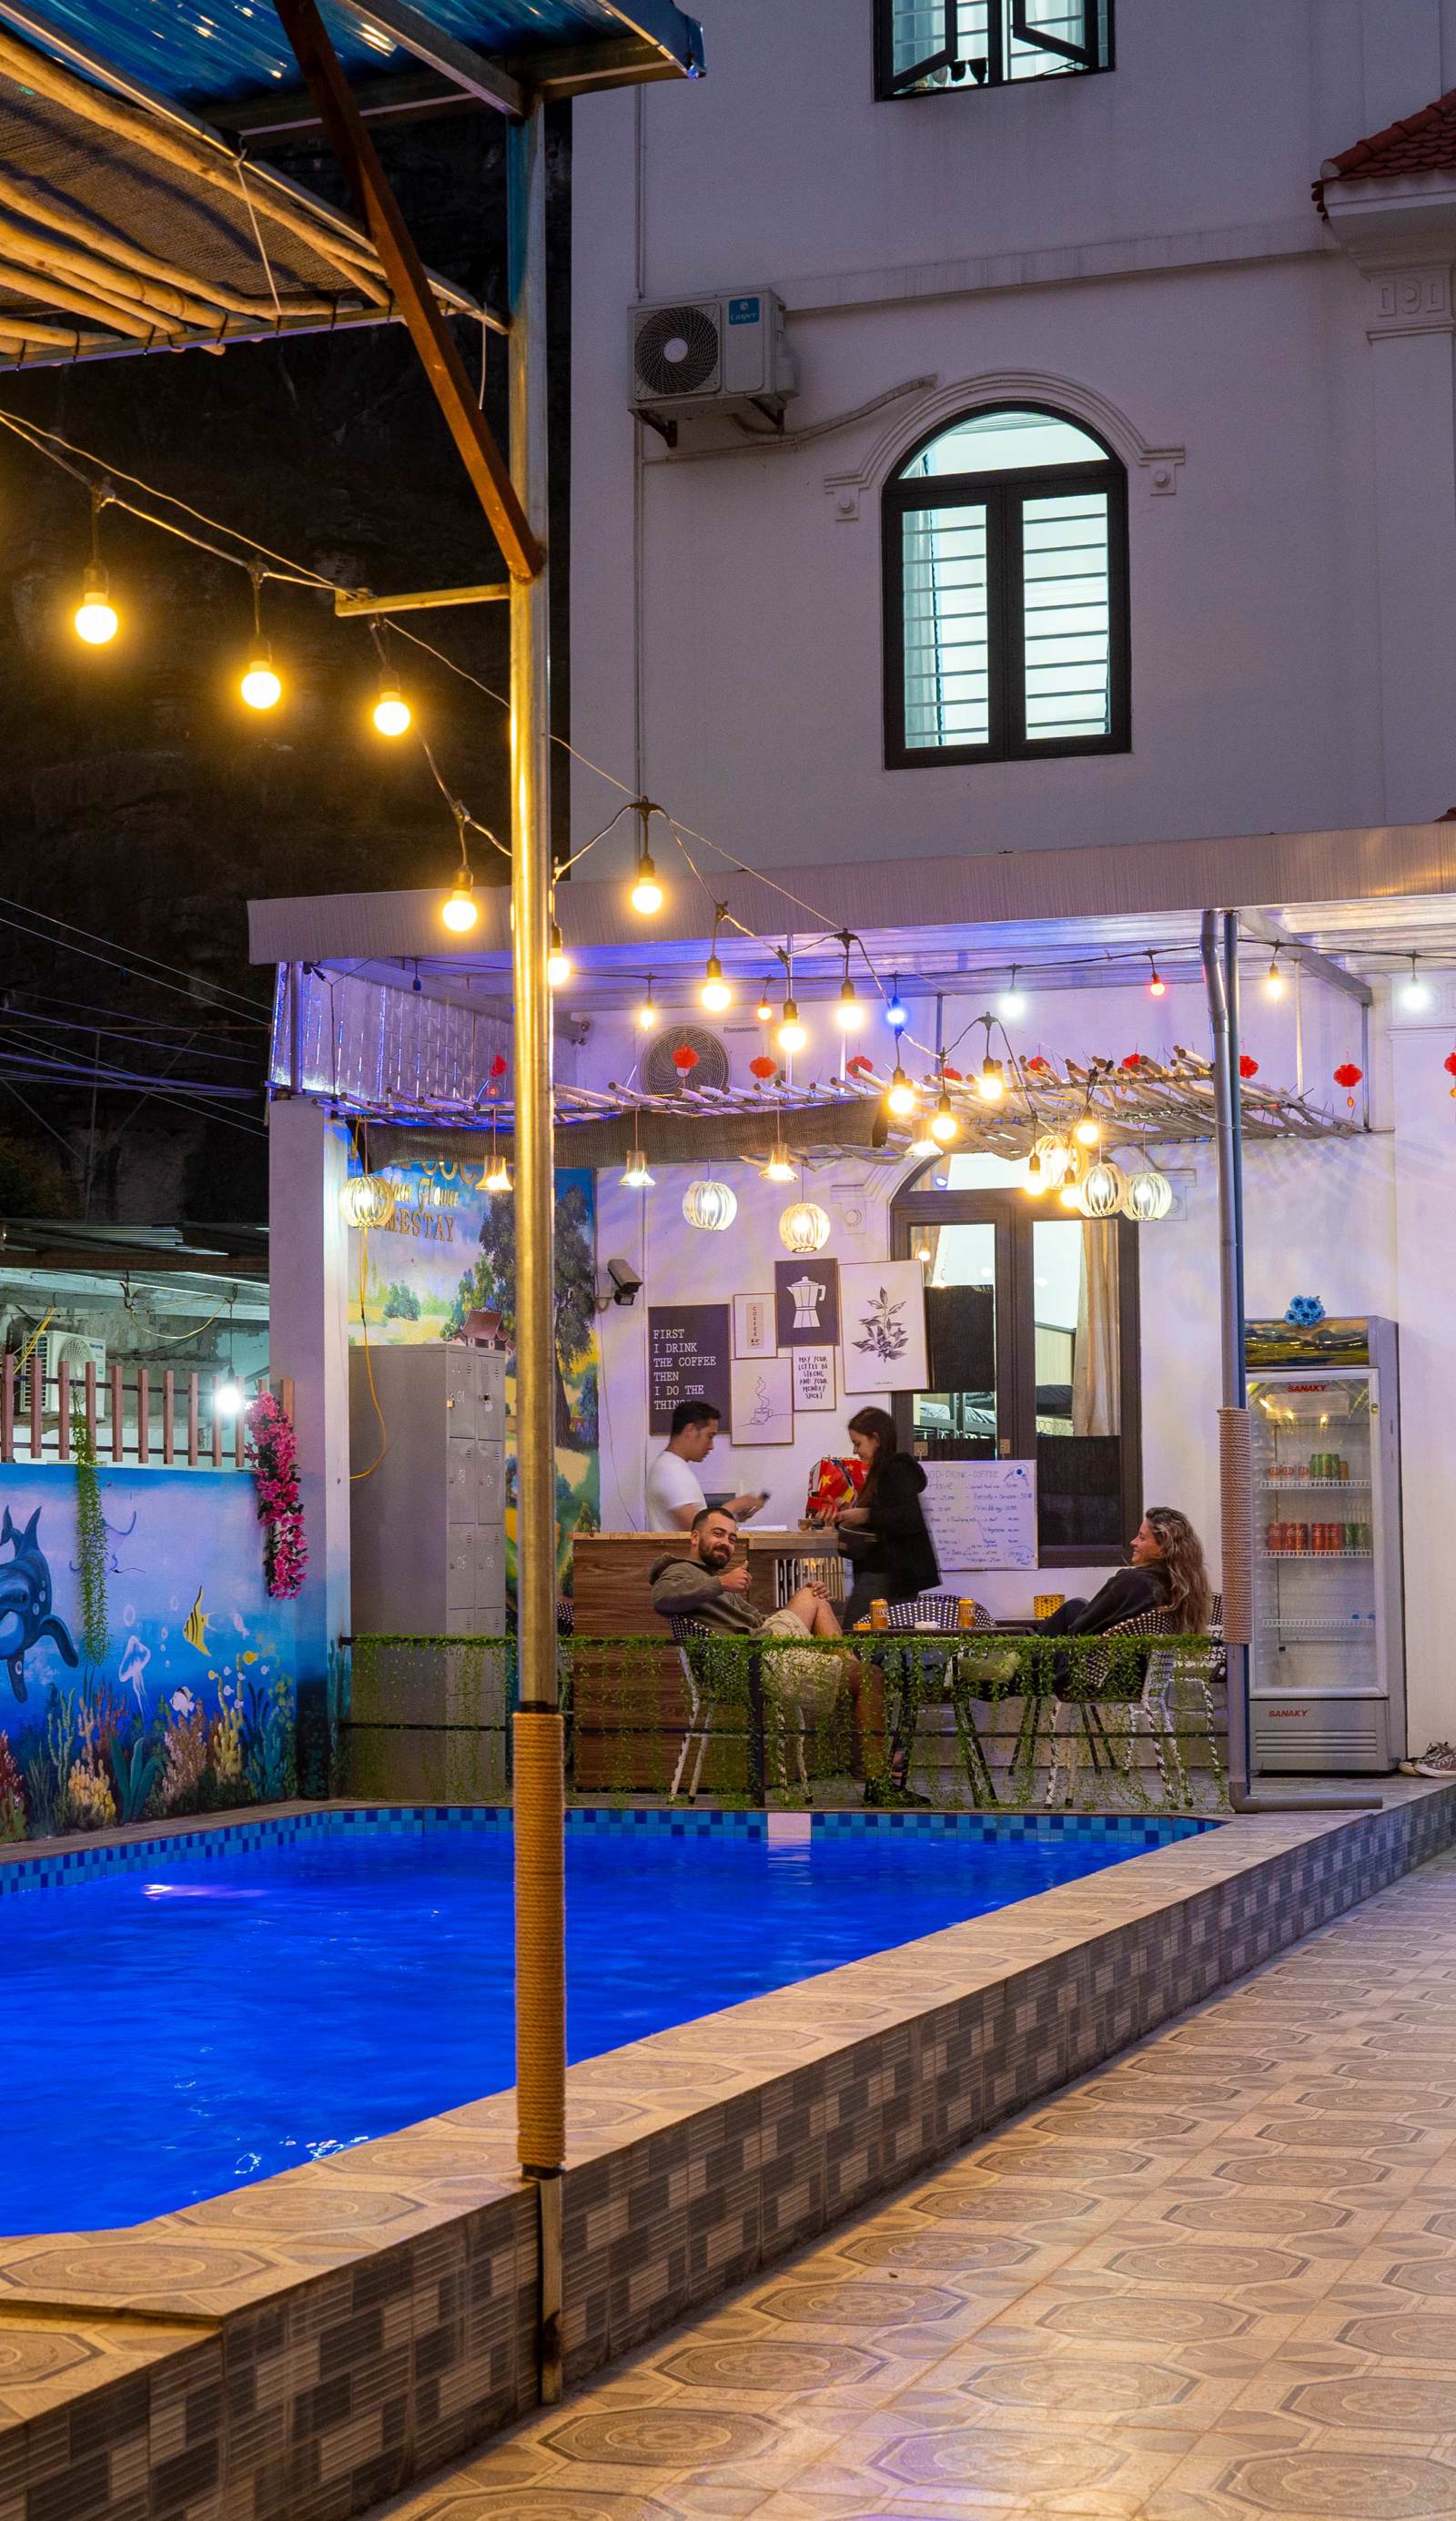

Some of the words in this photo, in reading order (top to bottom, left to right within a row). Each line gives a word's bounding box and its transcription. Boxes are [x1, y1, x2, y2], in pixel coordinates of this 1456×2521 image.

[653, 1329, 684, 1339] FIRST
[654, 1344, 659, 1352] I
[666, 1342, 698, 1352] DRINK
[653, 1357, 672, 1367] THE
[678, 1356, 716, 1367] COFFEE
[653, 1372, 679, 1382] THEN
[654, 1386, 660, 1395] I
[666, 1386, 679, 1395] DO
[684, 1384, 704, 1394] THE
[1288, 1384, 1327, 1392] SANAKY
[1269, 1709, 1309, 1717] SANAKY
